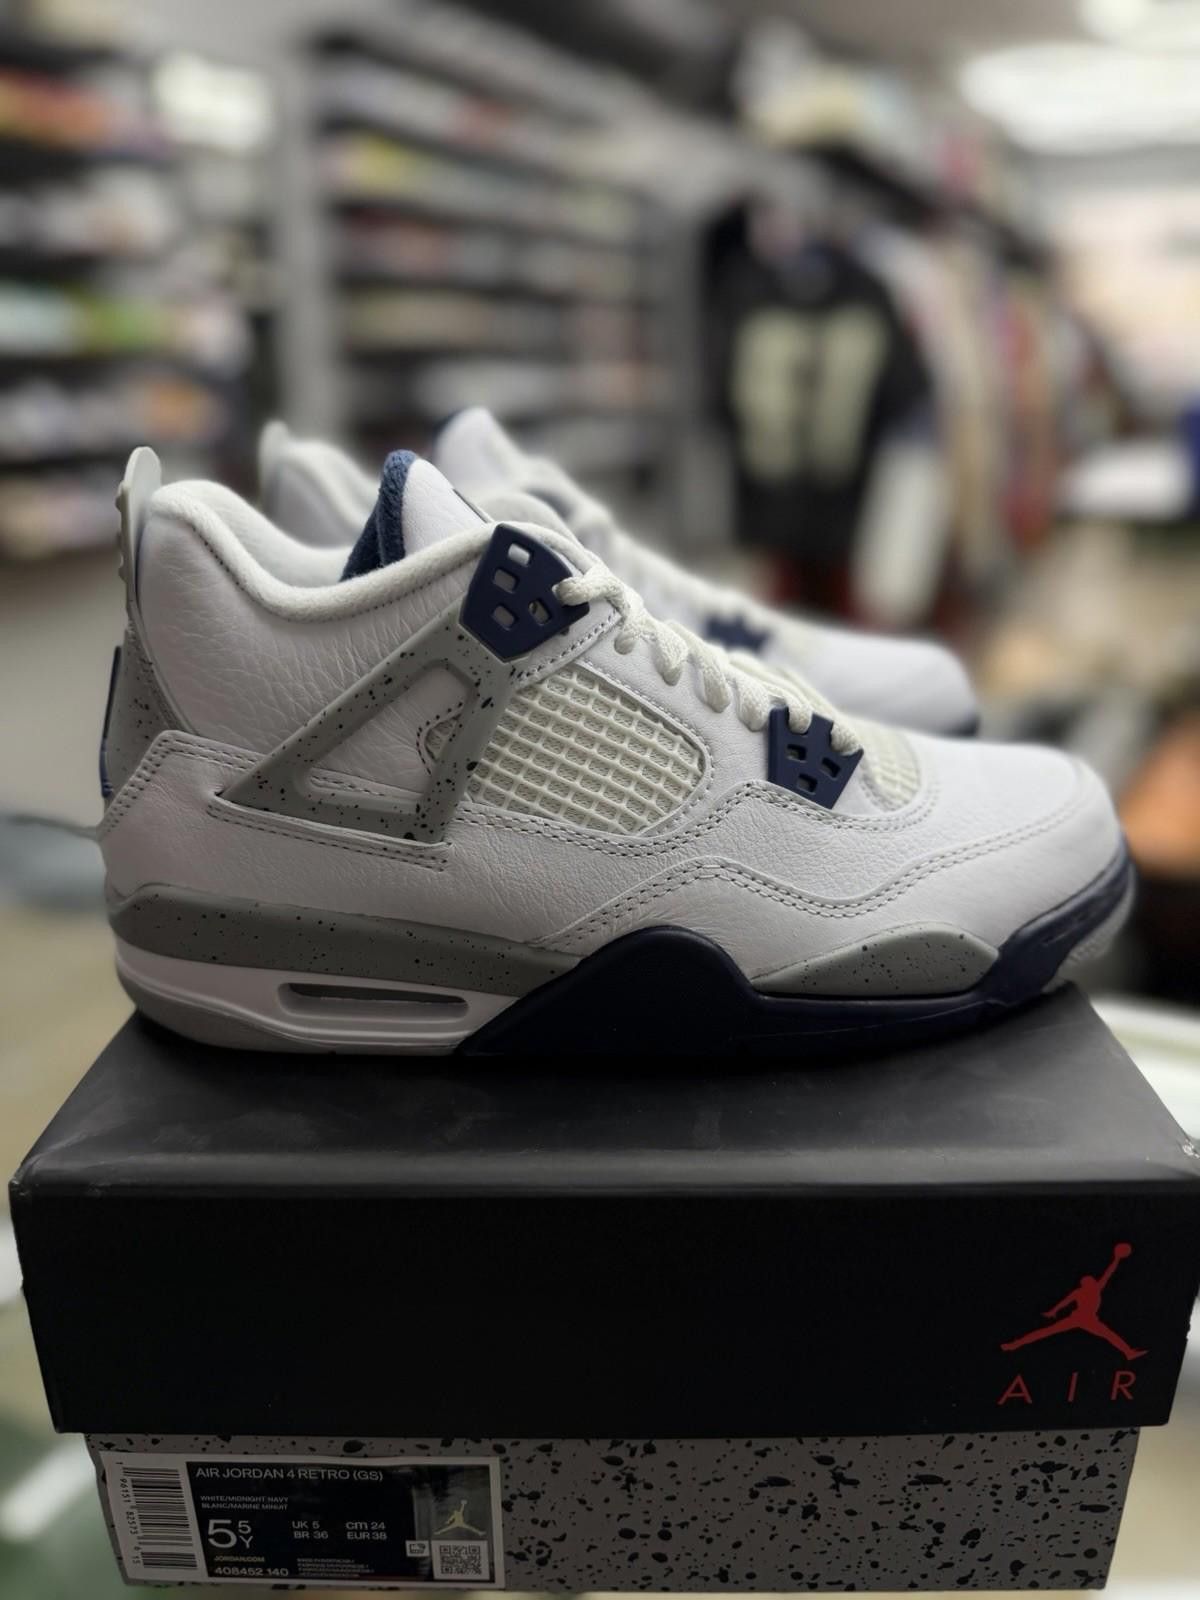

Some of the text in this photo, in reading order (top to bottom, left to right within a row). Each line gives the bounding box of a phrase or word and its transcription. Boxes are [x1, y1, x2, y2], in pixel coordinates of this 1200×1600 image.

[997, 1370, 1137, 1405] AIR
[195, 1467, 384, 1481] AIR JORDAN 4 RETRO (GS)
[200, 1495, 266, 1503] WHITE/MIDNIGHT
[292, 1521, 320, 1529] UK 5
[345, 1521, 386, 1530] cm 24
[207, 1519, 252, 1549] 5 5
[293, 1531, 329, 1539] BR 36
[346, 1532, 387, 1540] EUR 38
[239, 1535, 254, 1549] Y
[214, 1567, 264, 1577] 408452
[266, 1567, 289, 1577] 140
